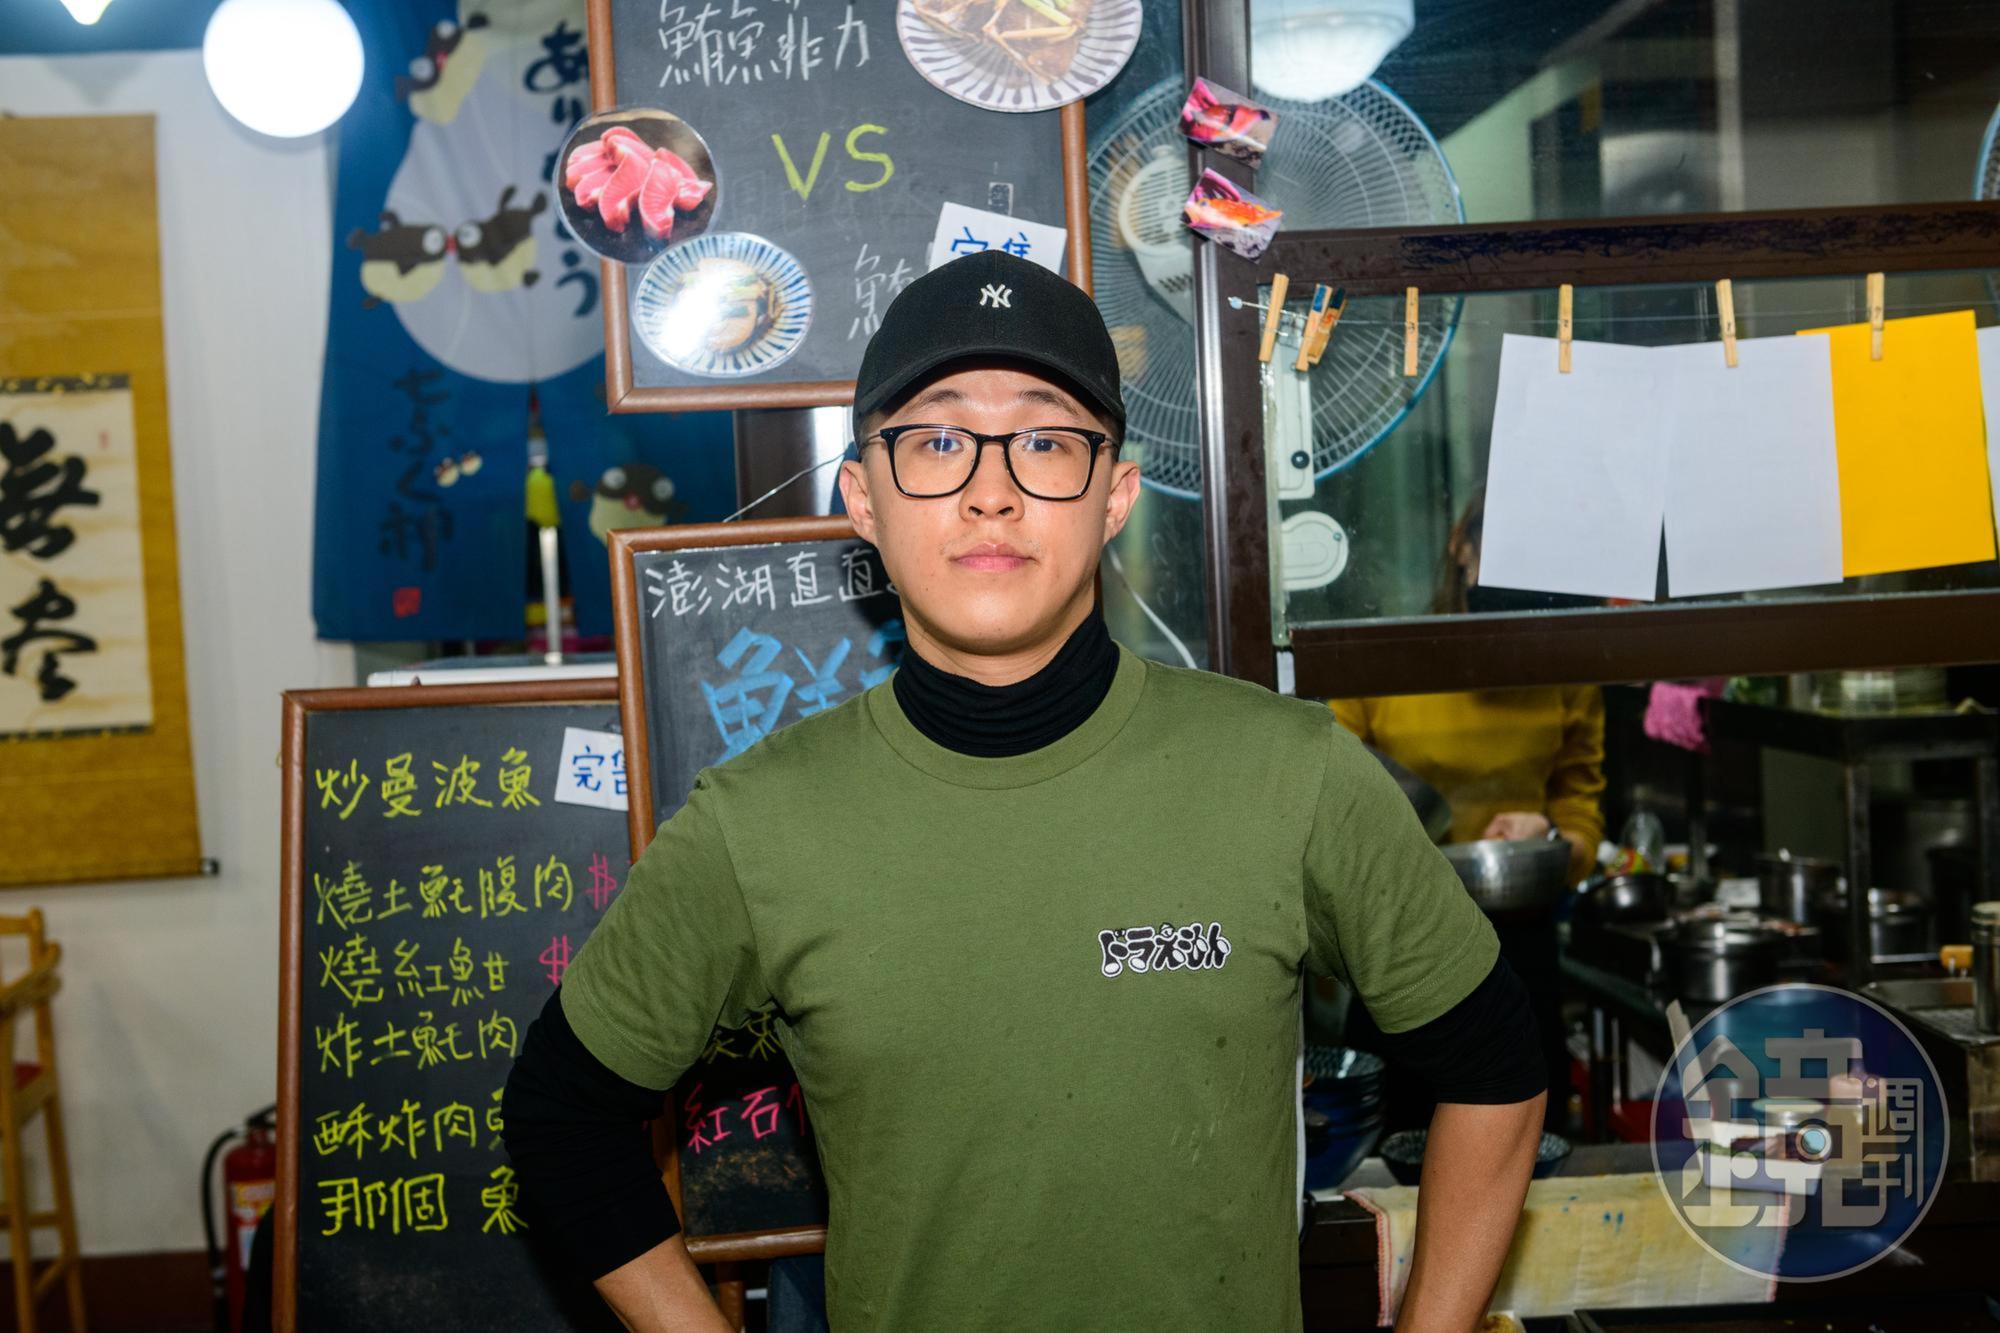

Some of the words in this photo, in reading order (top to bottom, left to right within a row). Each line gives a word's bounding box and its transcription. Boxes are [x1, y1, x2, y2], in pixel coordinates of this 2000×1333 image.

[771, 123, 895, 200] VS
[979, 283, 1013, 309] NY
[645, 551, 900, 618] 澎湖直直
[315, 747, 541, 820] 炒曼波魚
